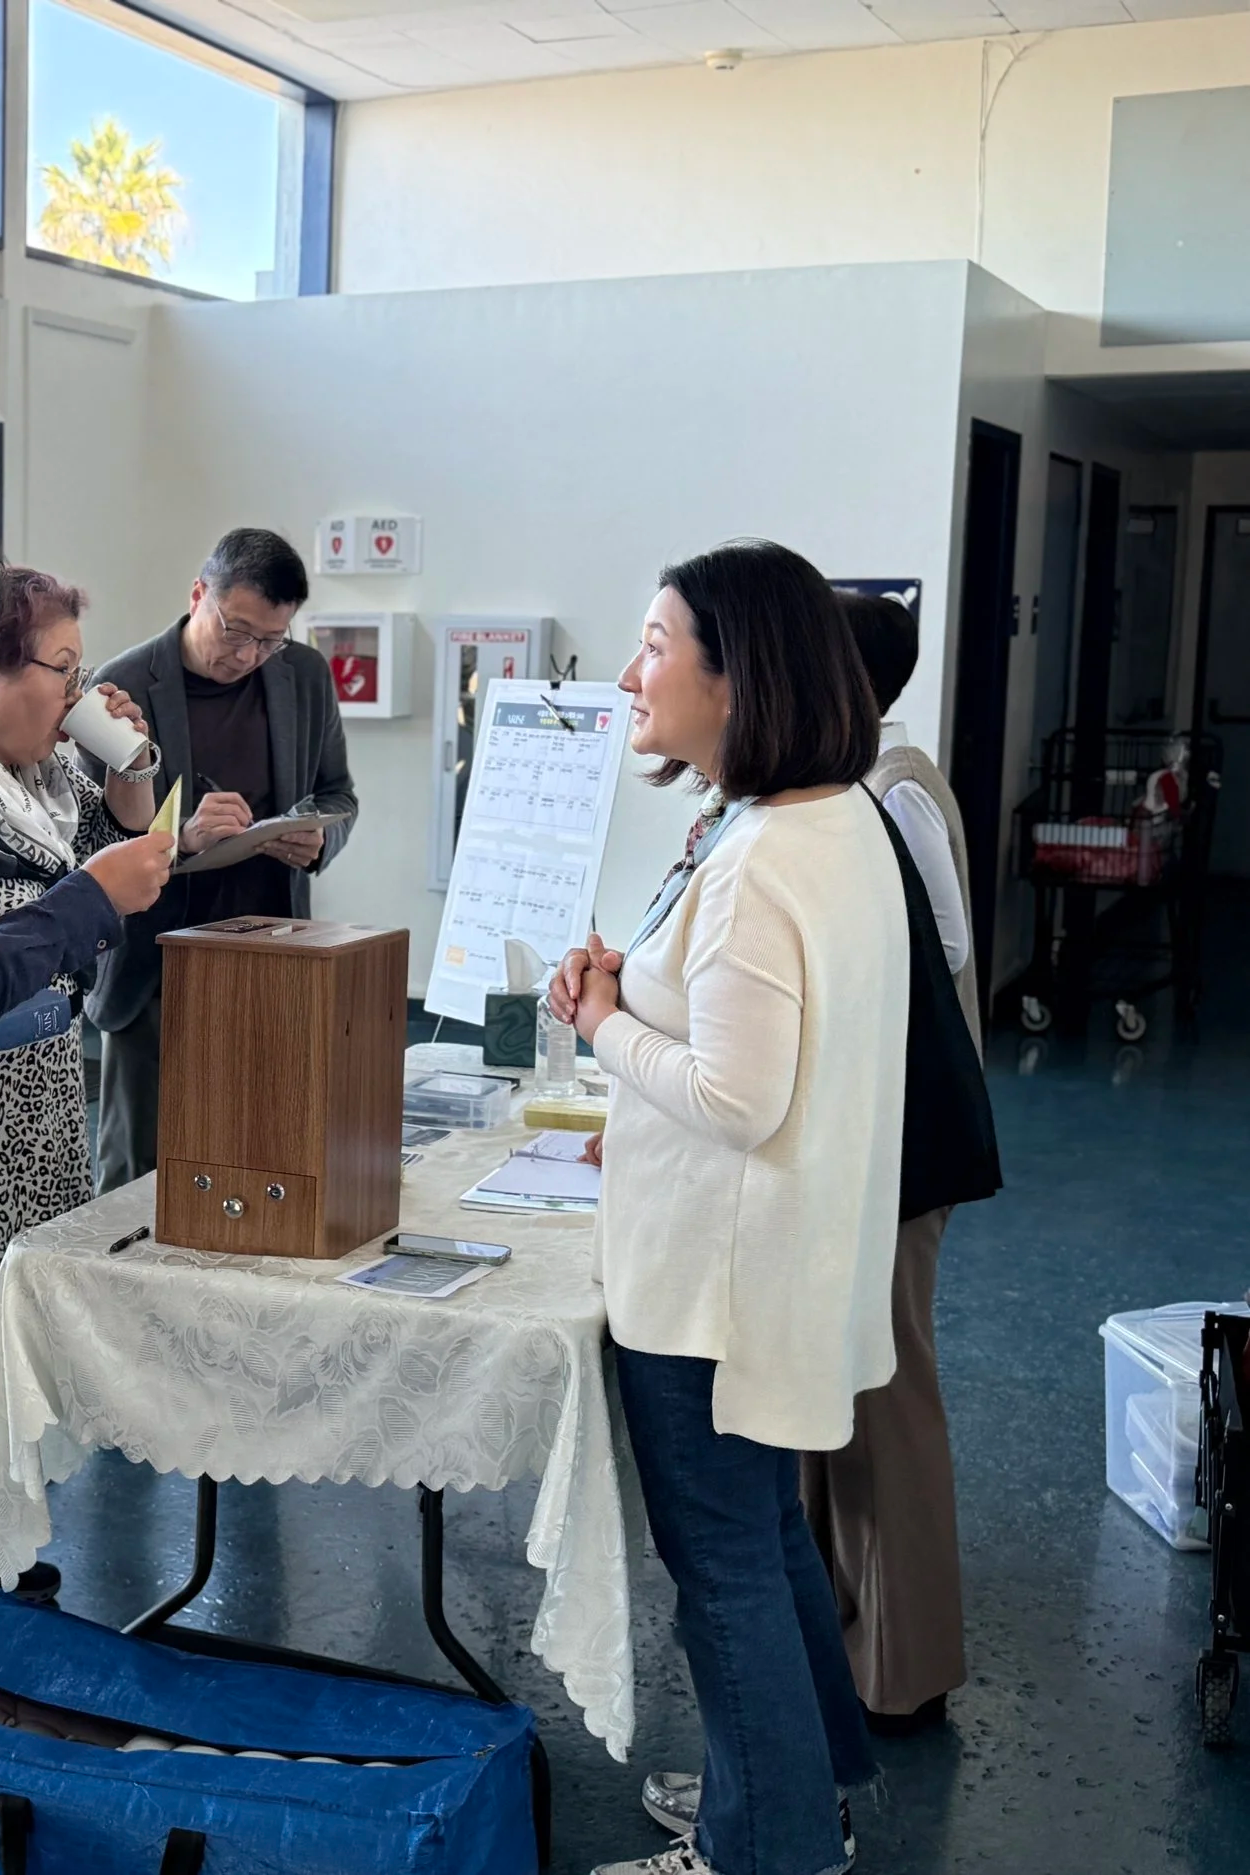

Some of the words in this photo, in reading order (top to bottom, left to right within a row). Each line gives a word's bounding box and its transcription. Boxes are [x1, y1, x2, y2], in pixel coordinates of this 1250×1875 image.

[371, 519, 398, 531] AED
[476, 632, 525, 642] BLANKET
[44, 1011, 52, 1032] NIV
